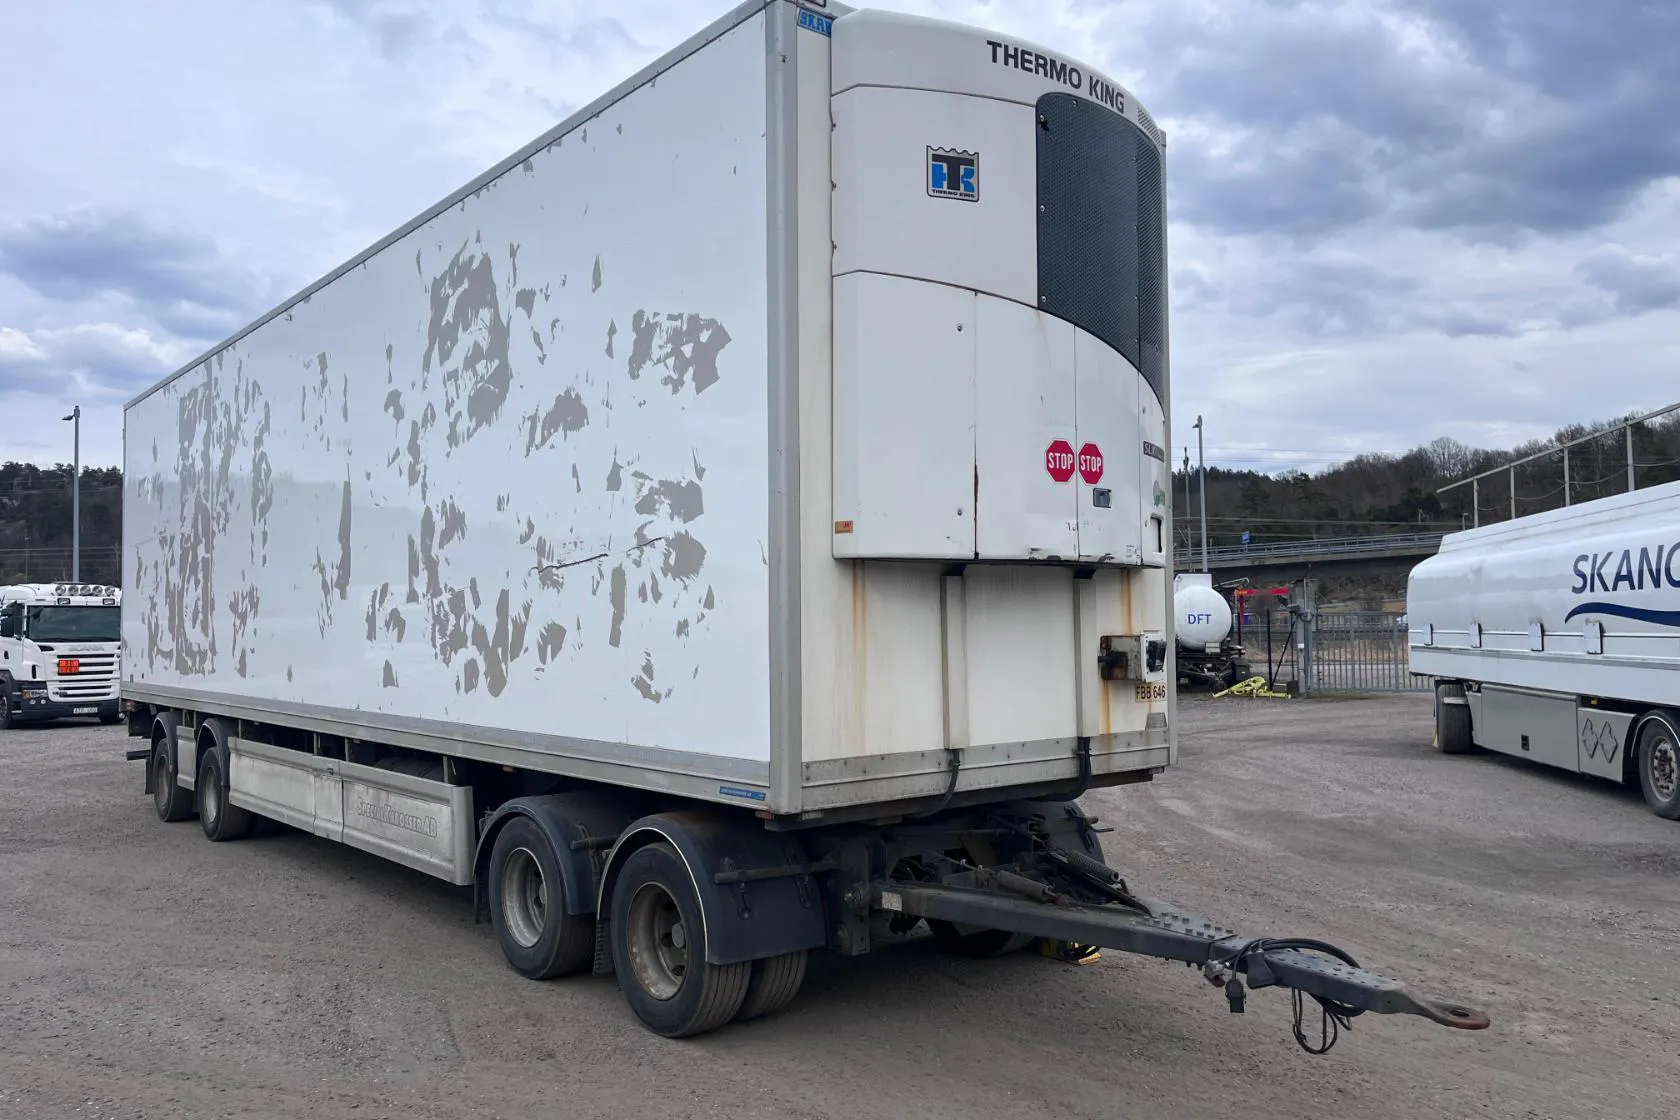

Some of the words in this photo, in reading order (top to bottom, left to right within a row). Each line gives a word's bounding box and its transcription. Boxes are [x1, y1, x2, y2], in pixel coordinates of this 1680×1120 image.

[987, 40, 1081, 89] THERMO
[1089, 75, 1124, 114] KING
[1048, 452, 1073, 470] STOP
[1080, 454, 1101, 472] STOP
[1187, 613, 1212, 625] DFT
[1136, 686, 1151, 699] FBB
[1153, 685, 1165, 699] 646
